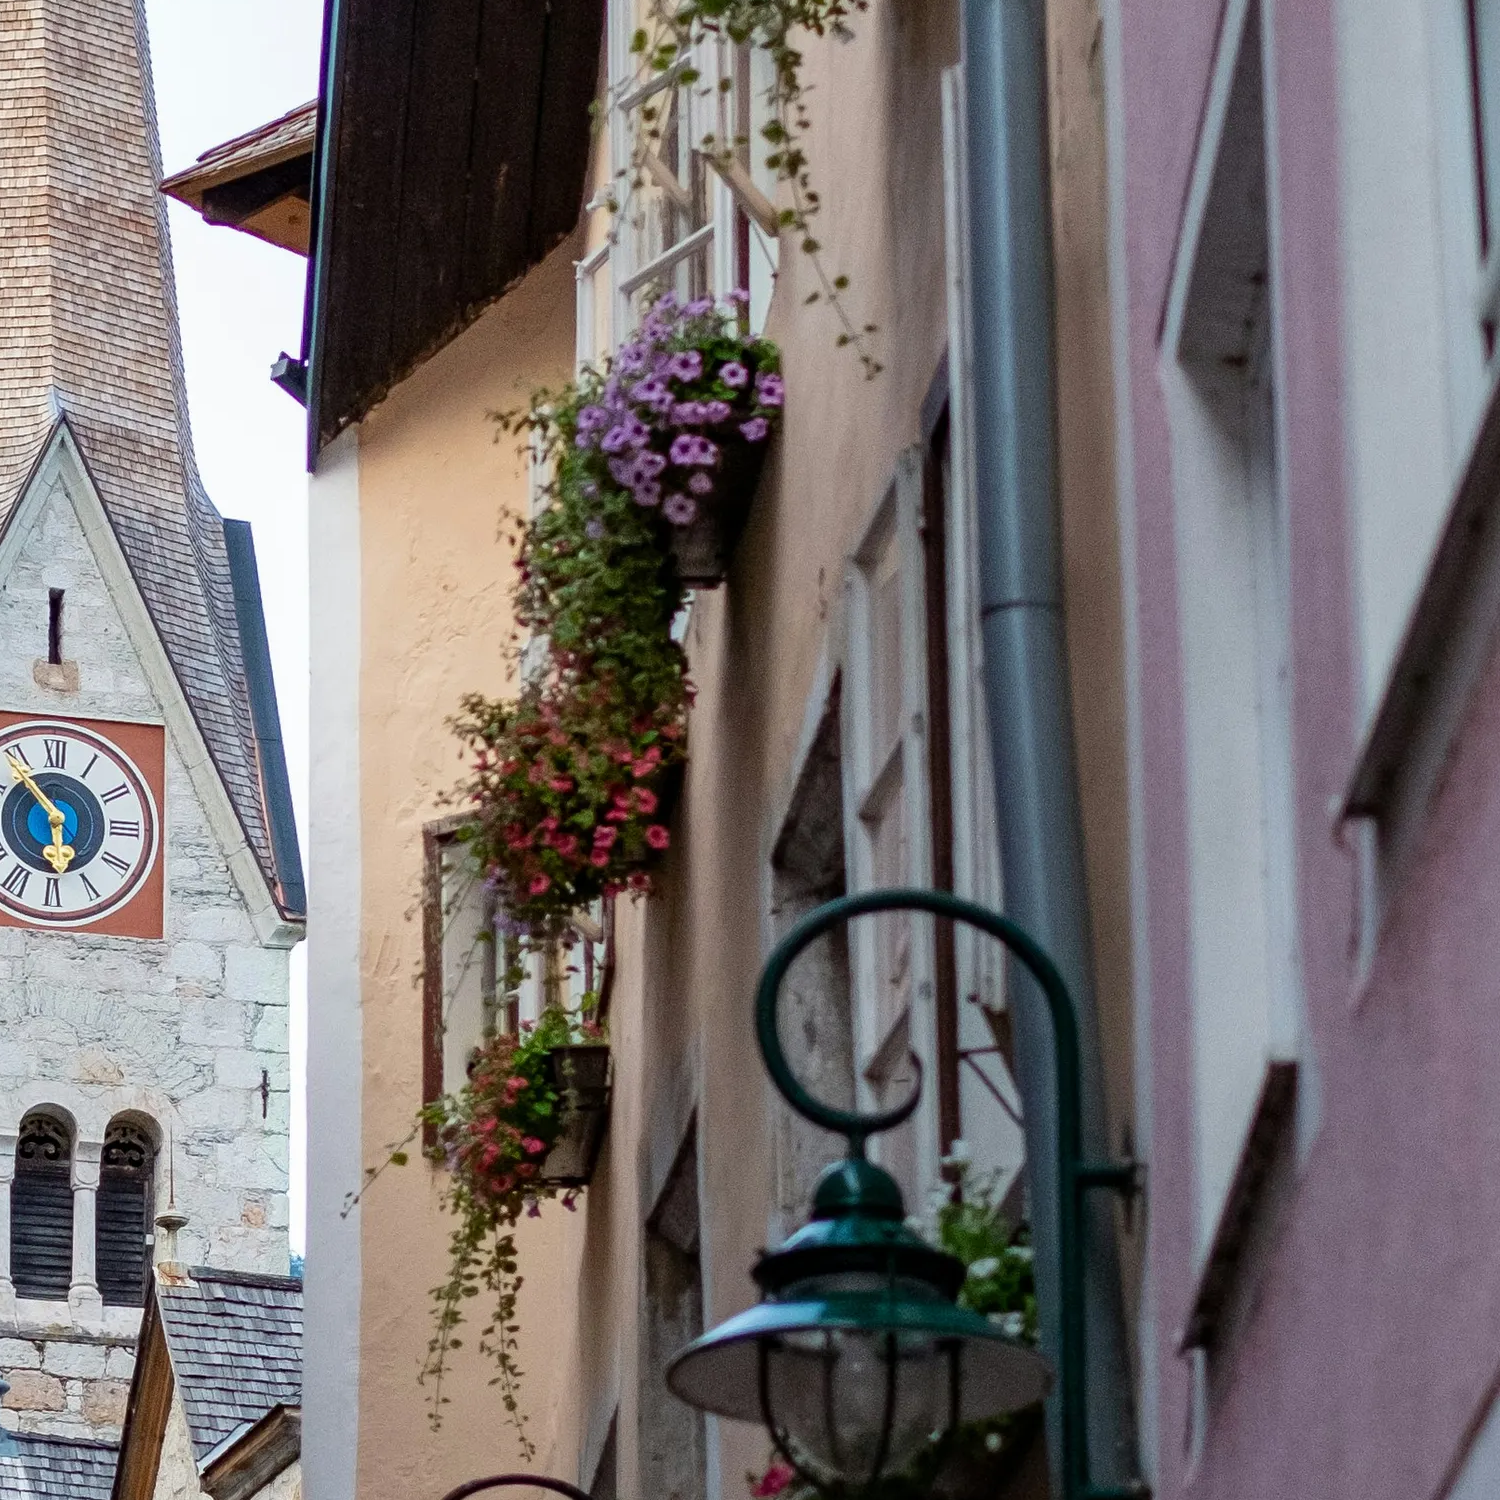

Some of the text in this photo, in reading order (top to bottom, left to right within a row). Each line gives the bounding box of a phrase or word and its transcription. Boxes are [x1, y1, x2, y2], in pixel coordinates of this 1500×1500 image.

[43, 739, 67, 770] XII
[80, 753, 99, 780] I
[101, 782, 131, 805] II
[109, 819, 139, 840] III
[101, 851, 131, 879] IV
[0, 863, 32, 899] VII
[42, 877, 62, 907] VI
[79, 872, 101, 901] V
